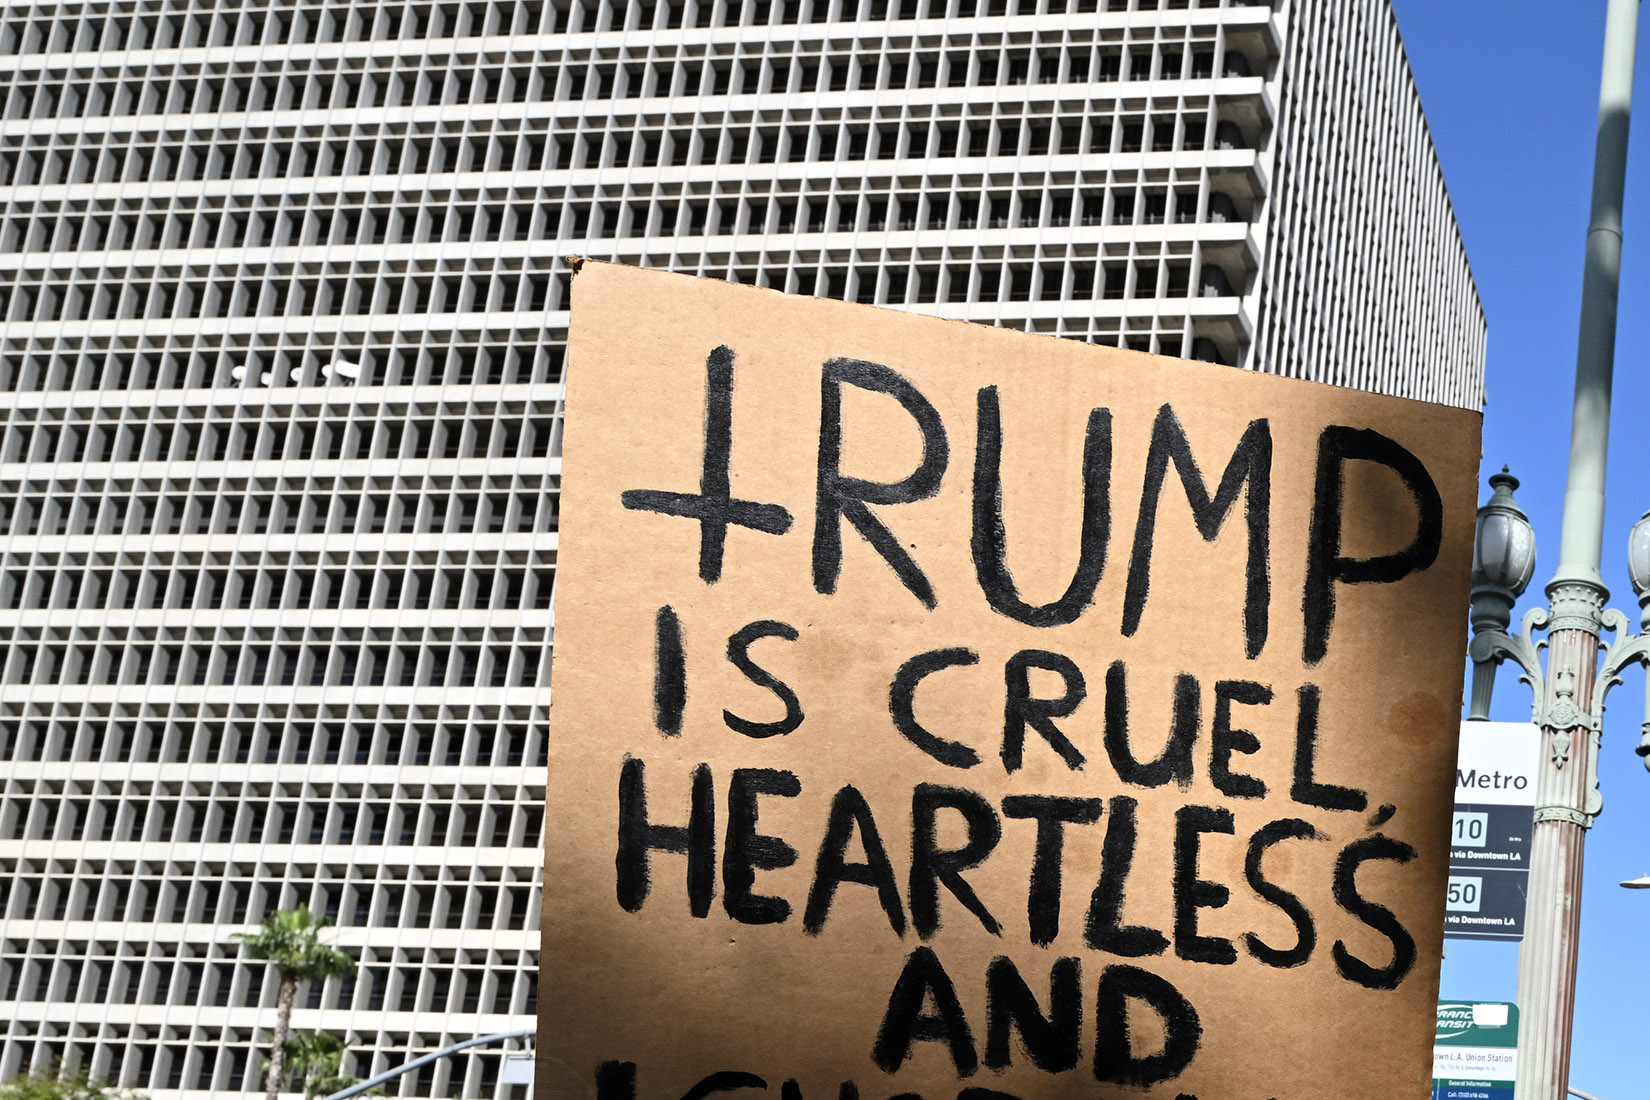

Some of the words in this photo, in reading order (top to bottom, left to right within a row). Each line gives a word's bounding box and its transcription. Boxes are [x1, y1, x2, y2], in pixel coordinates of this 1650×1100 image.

[653, 604, 804, 738] IS
[1456, 769, 1528, 790] Metro
[1454, 851, 1466, 859] via
[1467, 851, 1508, 860] Downtown
[1510, 852, 1521, 861] LA
[616, 753, 1418, 990] HEARTLESS
[1461, 916, 1502, 925] Downtown
[1504, 918, 1516, 926] LA
[872, 946, 1203, 1088] AND
[1465, 1053, 1486, 1062] Union
[1487, 1054, 1513, 1063] Station
